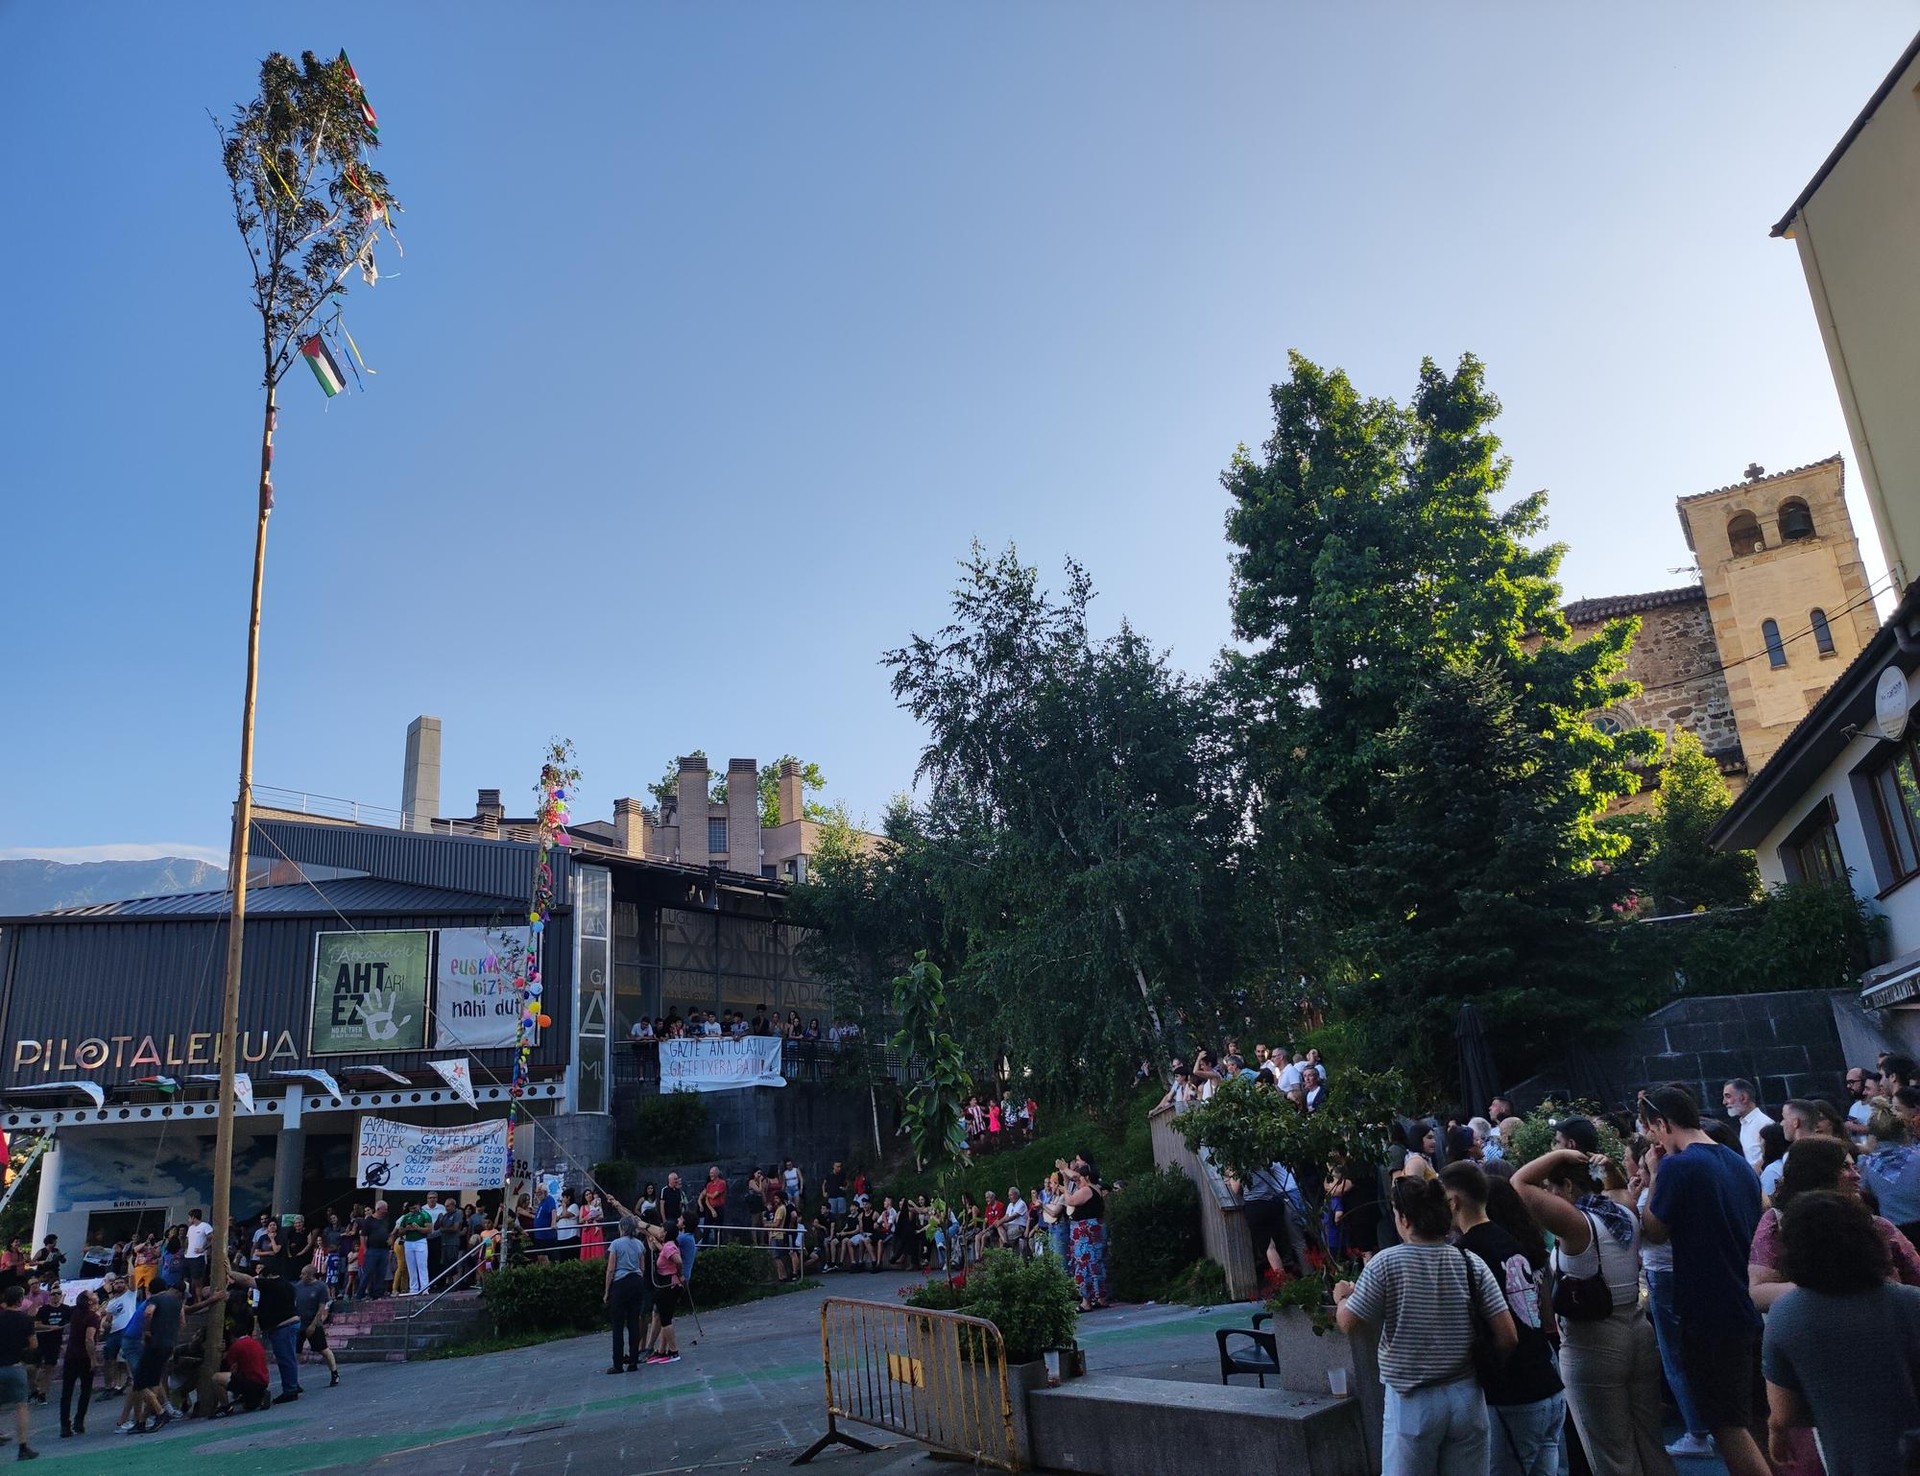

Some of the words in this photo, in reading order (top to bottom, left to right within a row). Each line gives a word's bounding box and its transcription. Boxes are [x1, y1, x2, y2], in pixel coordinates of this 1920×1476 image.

[331, 994, 365, 1026] EZ
[452, 1000, 486, 1018] nahi
[495, 999, 521, 1016] dut
[669, 1040, 700, 1058] GAZTE
[363, 1117, 408, 1134] APATAKO
[360, 1145, 392, 1157] 2025
[407, 1144, 434, 1155] 06/26
[483, 1145, 505, 1154] 01:00
[405, 1154, 432, 1165] 06/27
[478, 1155, 503, 1164] 22:00
[404, 1164, 431, 1174] 06/27
[478, 1165, 500, 1175] 01:30
[401, 1176, 427, 1186] 06/28
[478, 1177, 501, 1186] 21:00
